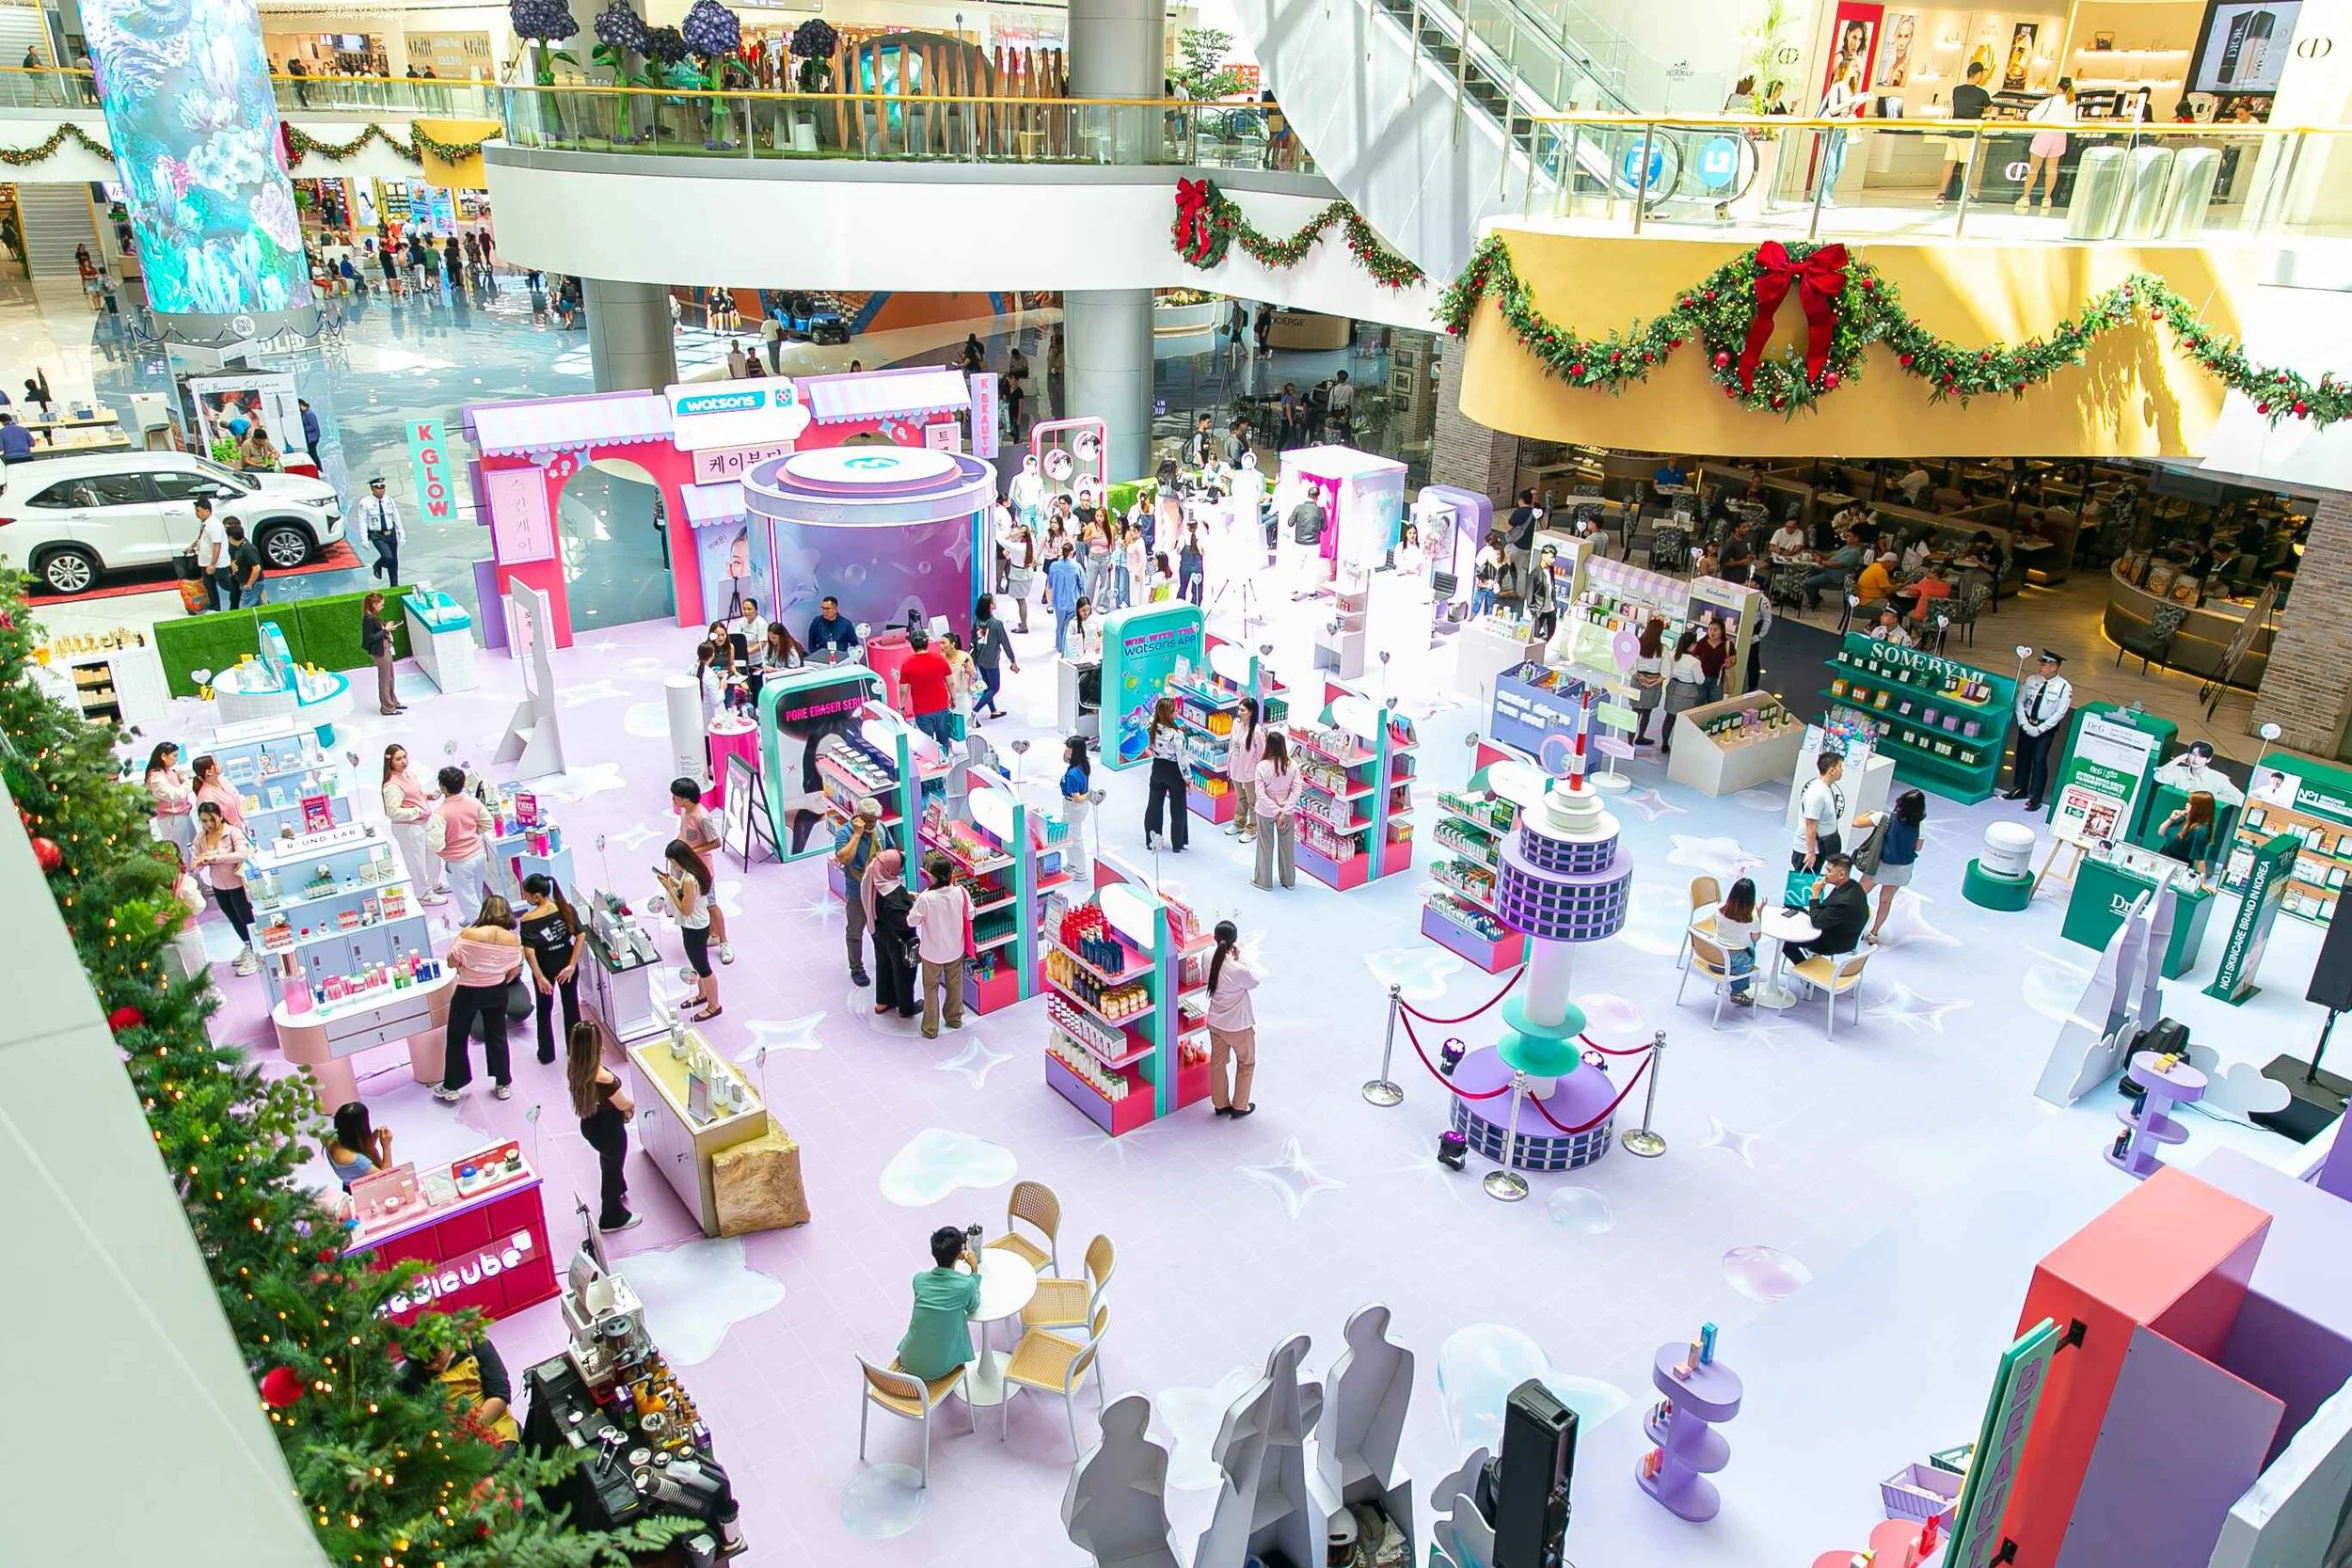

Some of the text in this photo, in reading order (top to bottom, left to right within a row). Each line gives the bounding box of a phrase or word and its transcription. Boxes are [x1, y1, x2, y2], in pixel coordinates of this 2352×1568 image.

[2227, 25, 2245, 58] DIOR
[1272, 315, 1306, 326] NCIERGE
[979, 376, 990, 389] K
[686, 394, 756, 413] watsons
[418, 424, 450, 517] K GLOW
[1124, 640, 1176, 657] watsons
[786, 706, 809, 722] PORE
[809, 701, 842, 718] ERASER
[2252, 860, 2271, 891] KOREA
[2239, 901, 2257, 931] BRAND
[2225, 929, 2247, 972] SKINCARE
[2219, 971, 2233, 990] NO.1
[373, 1247, 523, 1320] edicube
